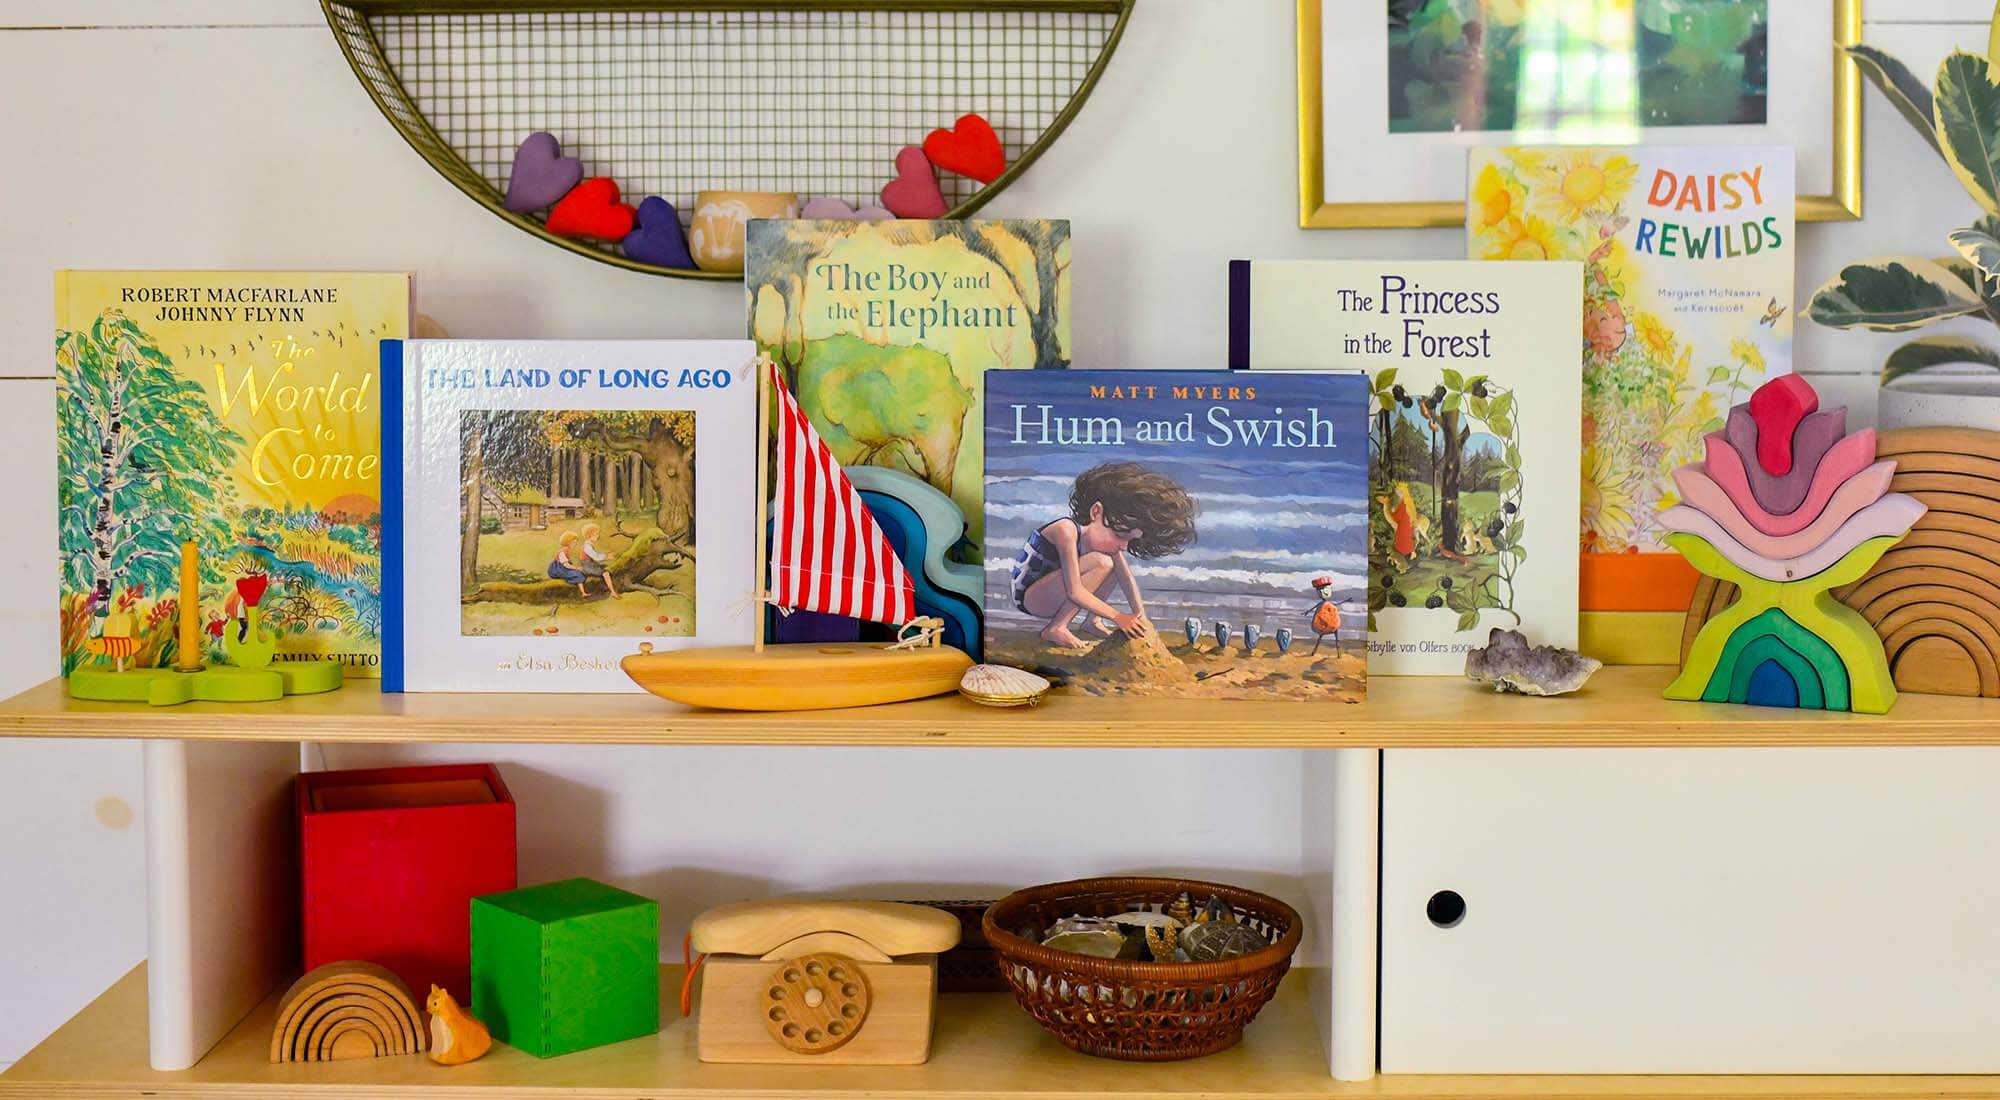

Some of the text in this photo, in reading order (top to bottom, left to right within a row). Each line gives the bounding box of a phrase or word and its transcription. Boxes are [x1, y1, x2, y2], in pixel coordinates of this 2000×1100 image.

[1647, 165, 1763, 213] DAISY
[1635, 216, 1782, 259] REWILDS
[121, 287, 338, 303] ROBERT MACFARLANE
[816, 263, 991, 301] The Boy and
[1337, 275, 1500, 314] The Princess
[1657, 288, 1761, 300] Margaret McNamara
[155, 306, 305, 323] JOHNNY FLYNN
[828, 299, 1017, 339] the Elephant
[271, 334, 315, 358] The
[1344, 319, 1491, 358] in the Forest
[214, 361, 372, 417] World
[427, 368, 732, 389] THE LAND OF LONG AGO
[1090, 385, 1257, 400] MATT MYERS
[314, 424, 336, 441] to
[1010, 405, 1337, 448] Hum and Swish
[251, 427, 378, 486] Come
[327, 653, 379, 666] SUTTO
[1400, 644, 1416, 652] von
[1419, 641, 1448, 653] Olfers
